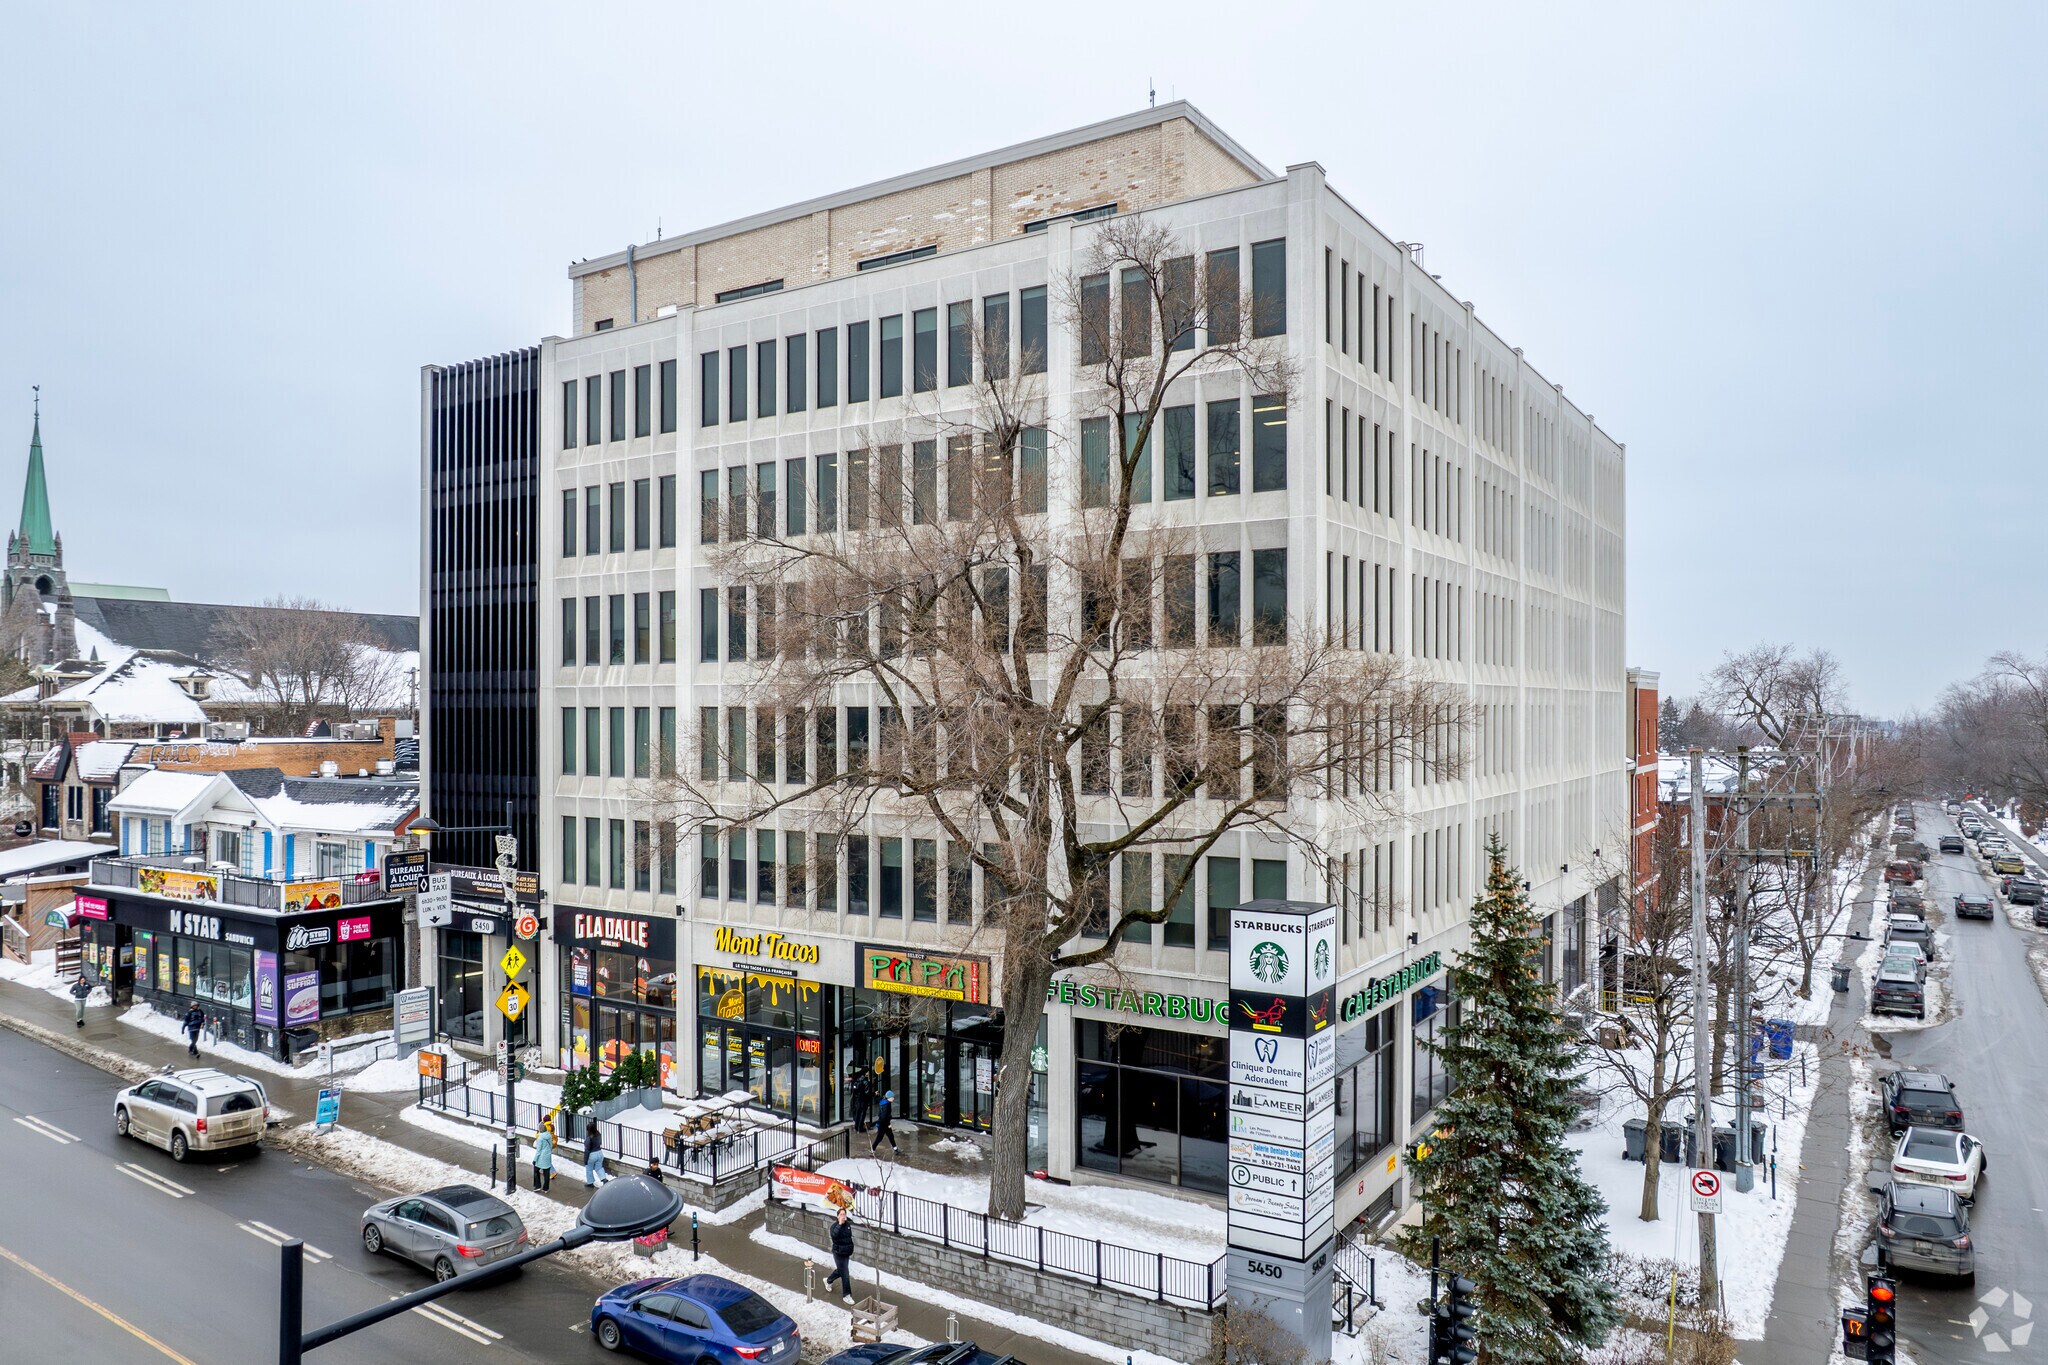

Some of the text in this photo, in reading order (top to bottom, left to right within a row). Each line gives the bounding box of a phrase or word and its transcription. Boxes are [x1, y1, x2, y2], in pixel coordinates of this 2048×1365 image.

[389, 865, 424, 875] BUREAUX
[451, 870, 501, 881] BUREAUX À LOUE
[391, 875, 397, 883] À
[432, 876, 446, 884] BUS
[170, 909, 221, 940] M STAR
[475, 922, 490, 931] 5450
[522, 919, 532, 932] G
[1234, 920, 1303, 934] STARBUCKS
[1308, 916, 1335, 933] STARBUCKS
[225, 932, 254, 946] SANDWICH
[309, 930, 327, 939] STAR
[714, 926, 819, 964] Mont Tacos
[771, 968, 793, 976] FRANÇAISE
[869, 955, 912, 983] Piri
[920, 961, 965, 990] Piri
[287, 979, 316, 991] SUFFIRA
[1342, 951, 1442, 1023] CAFÉ STARBUCKS
[508, 1003, 518, 1012] 30
[727, 996, 742, 1007] Mont
[1079, 984, 1229, 1025] STARBUC
[720, 1003, 744, 1018] Tacos
[799, 1039, 820, 1054] OUVERT
[661, 1062, 668, 1072] G
[1231, 1060, 1302, 1078] Clinique Dentaire
[1244, 1073, 1288, 1087] Adoradent
[1254, 1096, 1302, 1112] LAMEER
[1253, 1143, 1303, 1159] Galerie Dentaire Soleil
[1261, 1159, 1301, 1171] 514-731-1443
[1252, 1174, 1285, 1187] PUBLIC
[1284, 1201, 1300, 1210] Salon
[1248, 1260, 1282, 1279] 5450
[1312, 1253, 1327, 1276] 5450
